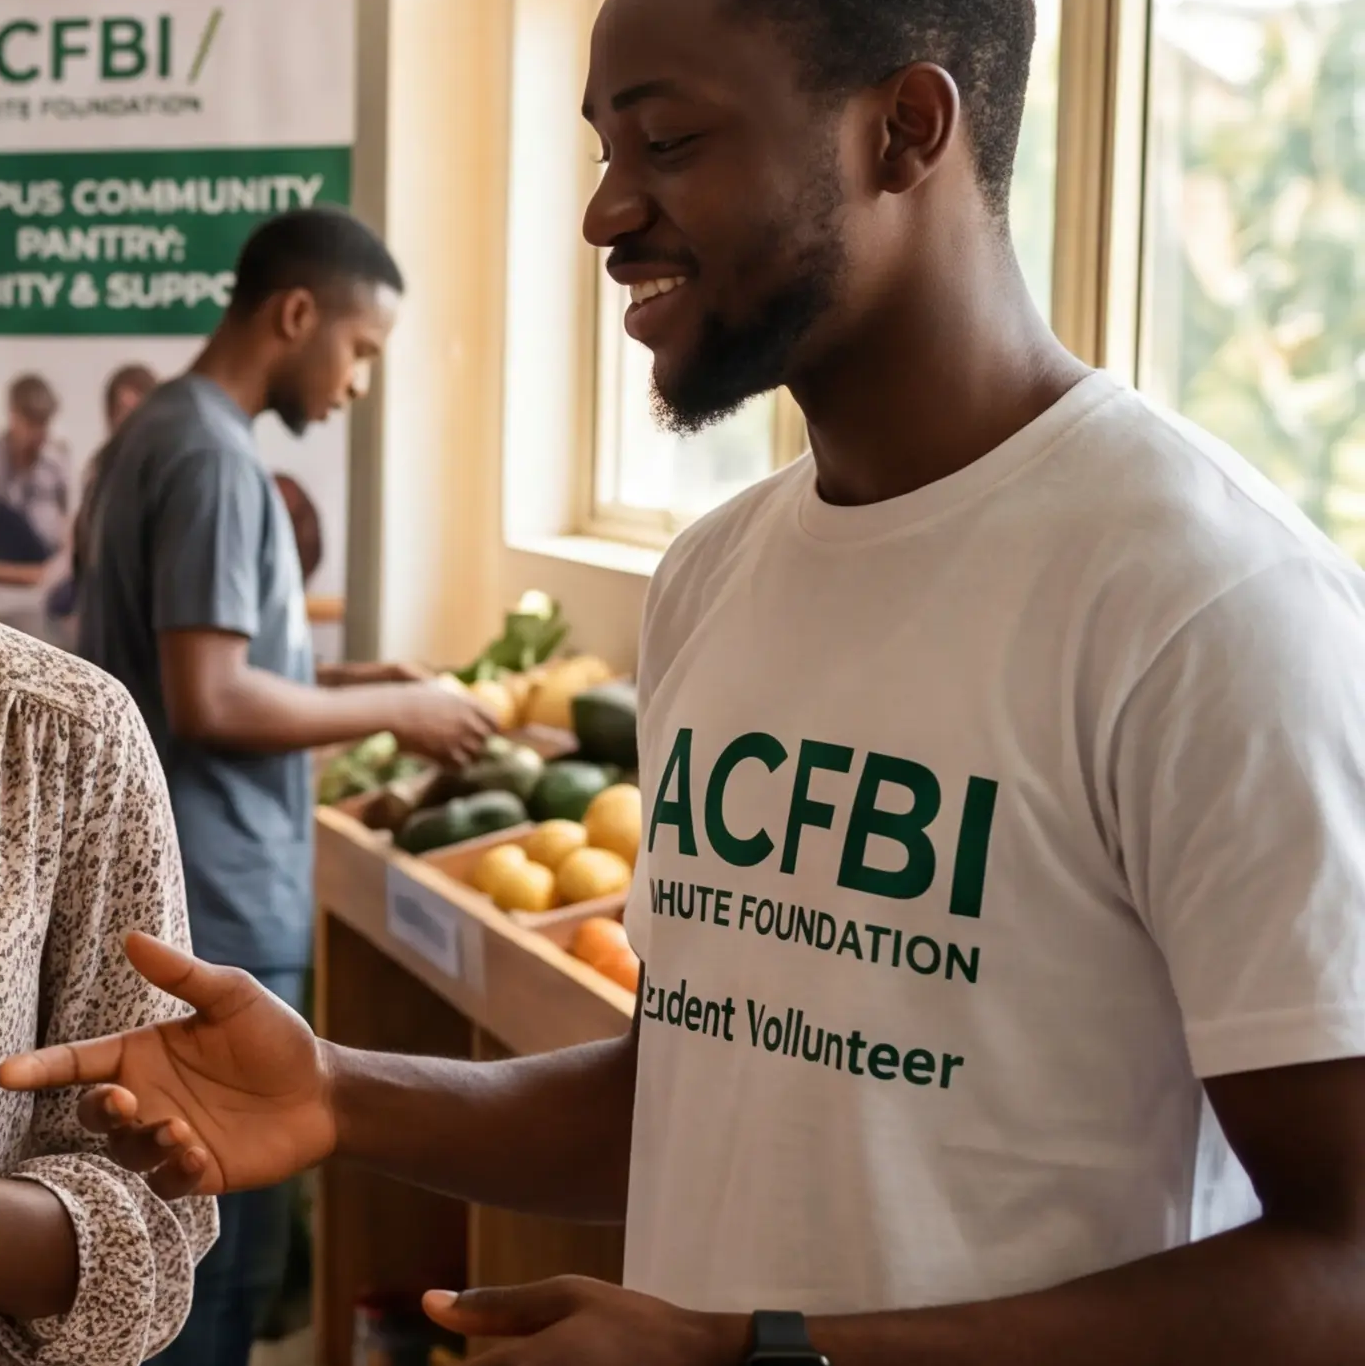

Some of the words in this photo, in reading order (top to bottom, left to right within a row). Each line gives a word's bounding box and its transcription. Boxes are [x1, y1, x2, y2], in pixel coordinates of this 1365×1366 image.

[72, 173, 324, 217] COMMUNITY
[15, 224, 186, 263] PANTRY:
[67, 272, 99, 308] &
[105, 270, 237, 310] SUPPO
[647, 726, 999, 919] ACFBI
[738, 894, 981, 984] FOUNDATION
